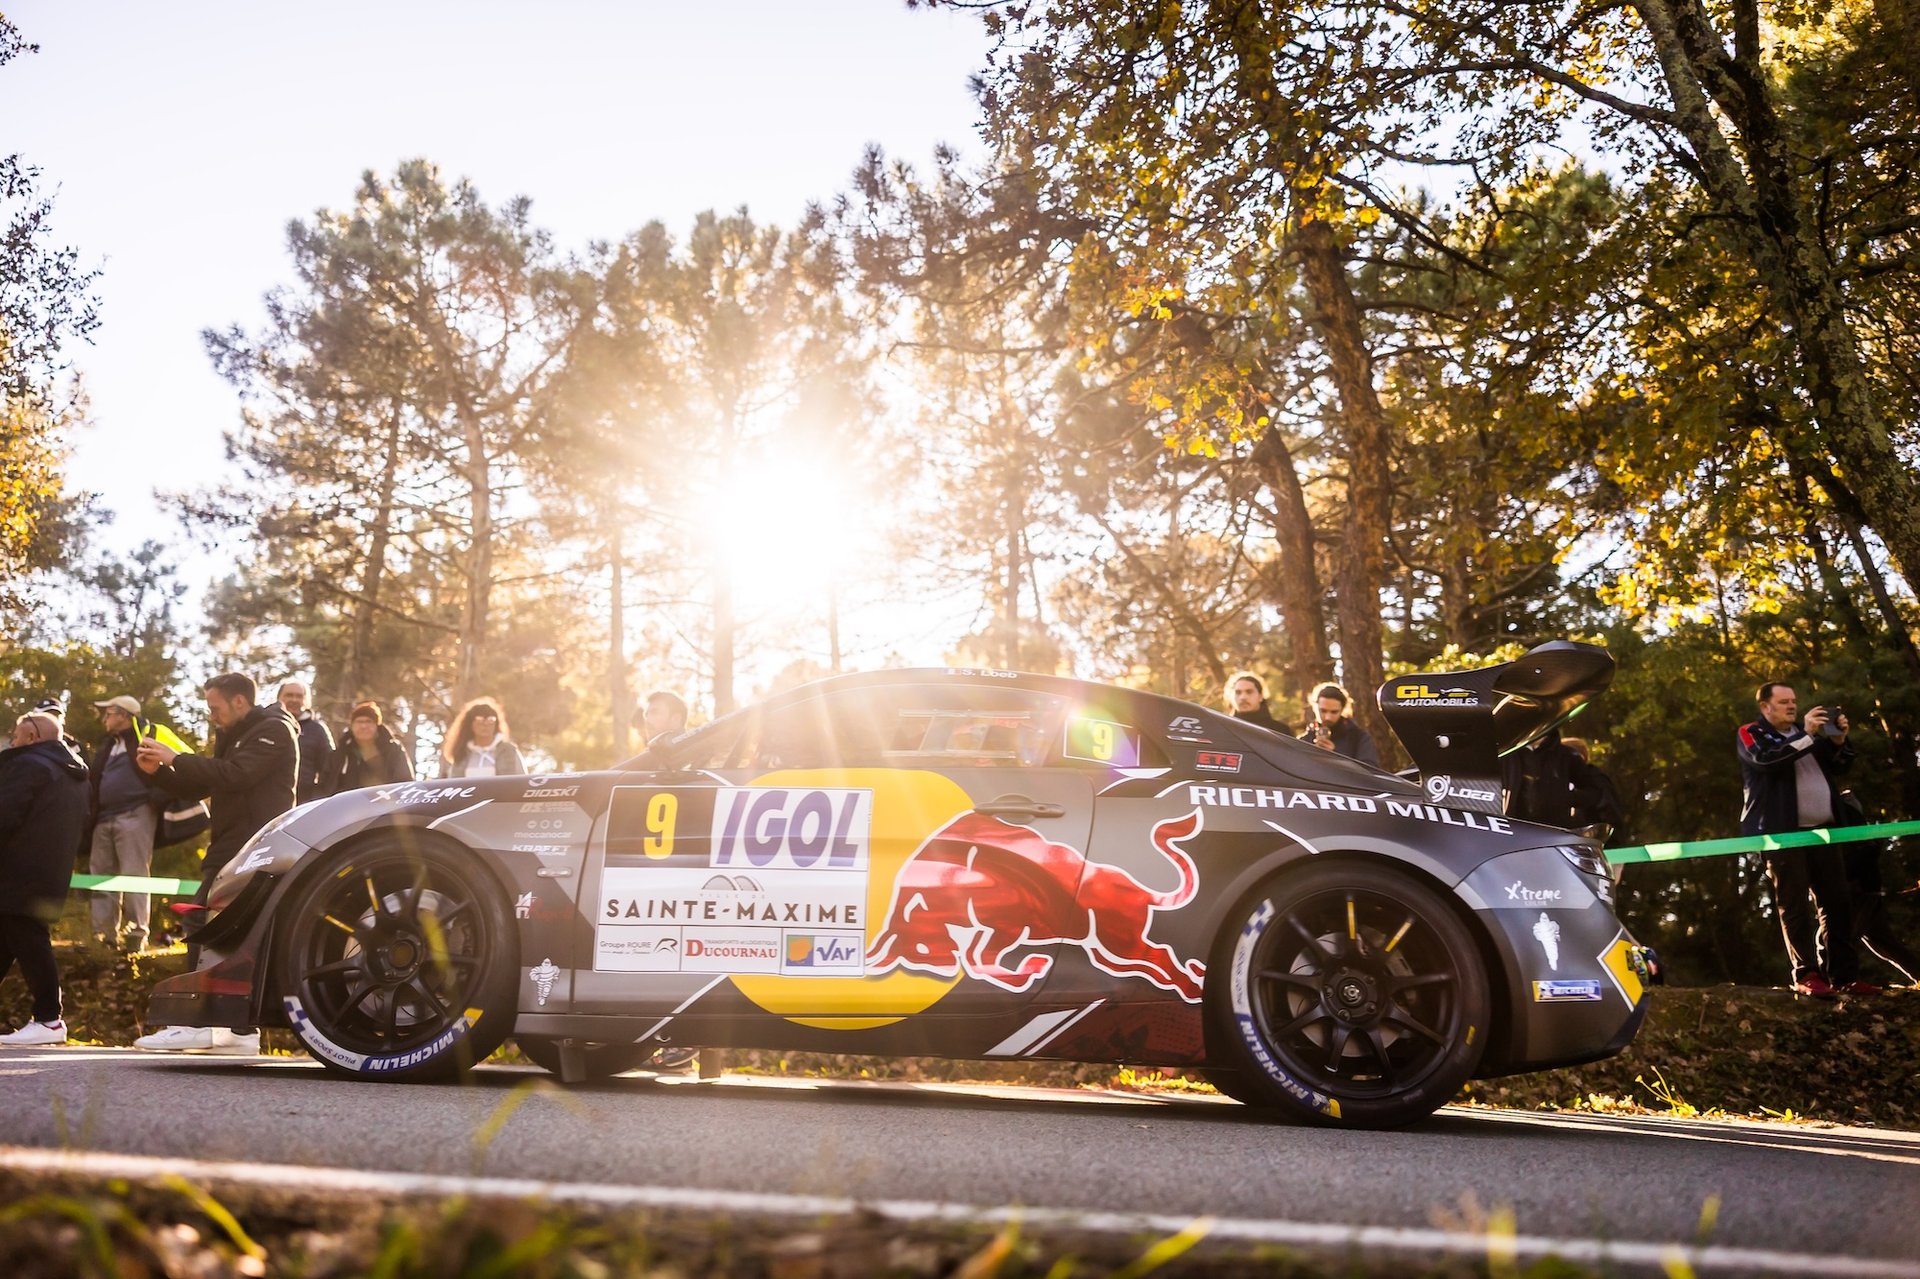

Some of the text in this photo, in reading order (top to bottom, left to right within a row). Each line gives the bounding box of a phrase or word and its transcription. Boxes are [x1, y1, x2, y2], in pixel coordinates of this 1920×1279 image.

[1396, 685, 1440, 699] GL
[1398, 698, 1479, 707] AUTOMOBILES
[1093, 723, 1113, 761] 9
[1197, 753, 1239, 767] ETS
[643, 792, 678, 860] 9
[1189, 785, 1514, 836] RICHARD MILLE
[716, 790, 860, 867] IGOL
[606, 900, 858, 924] SAINTE-MAXIME
[685, 939, 778, 959] DUCOURNAU
[308, 1034, 357, 1065] PILOT SPORT
[368, 1031, 455, 1071] MICHELIN
[1240, 1019, 1309, 1100] MICHELIN
